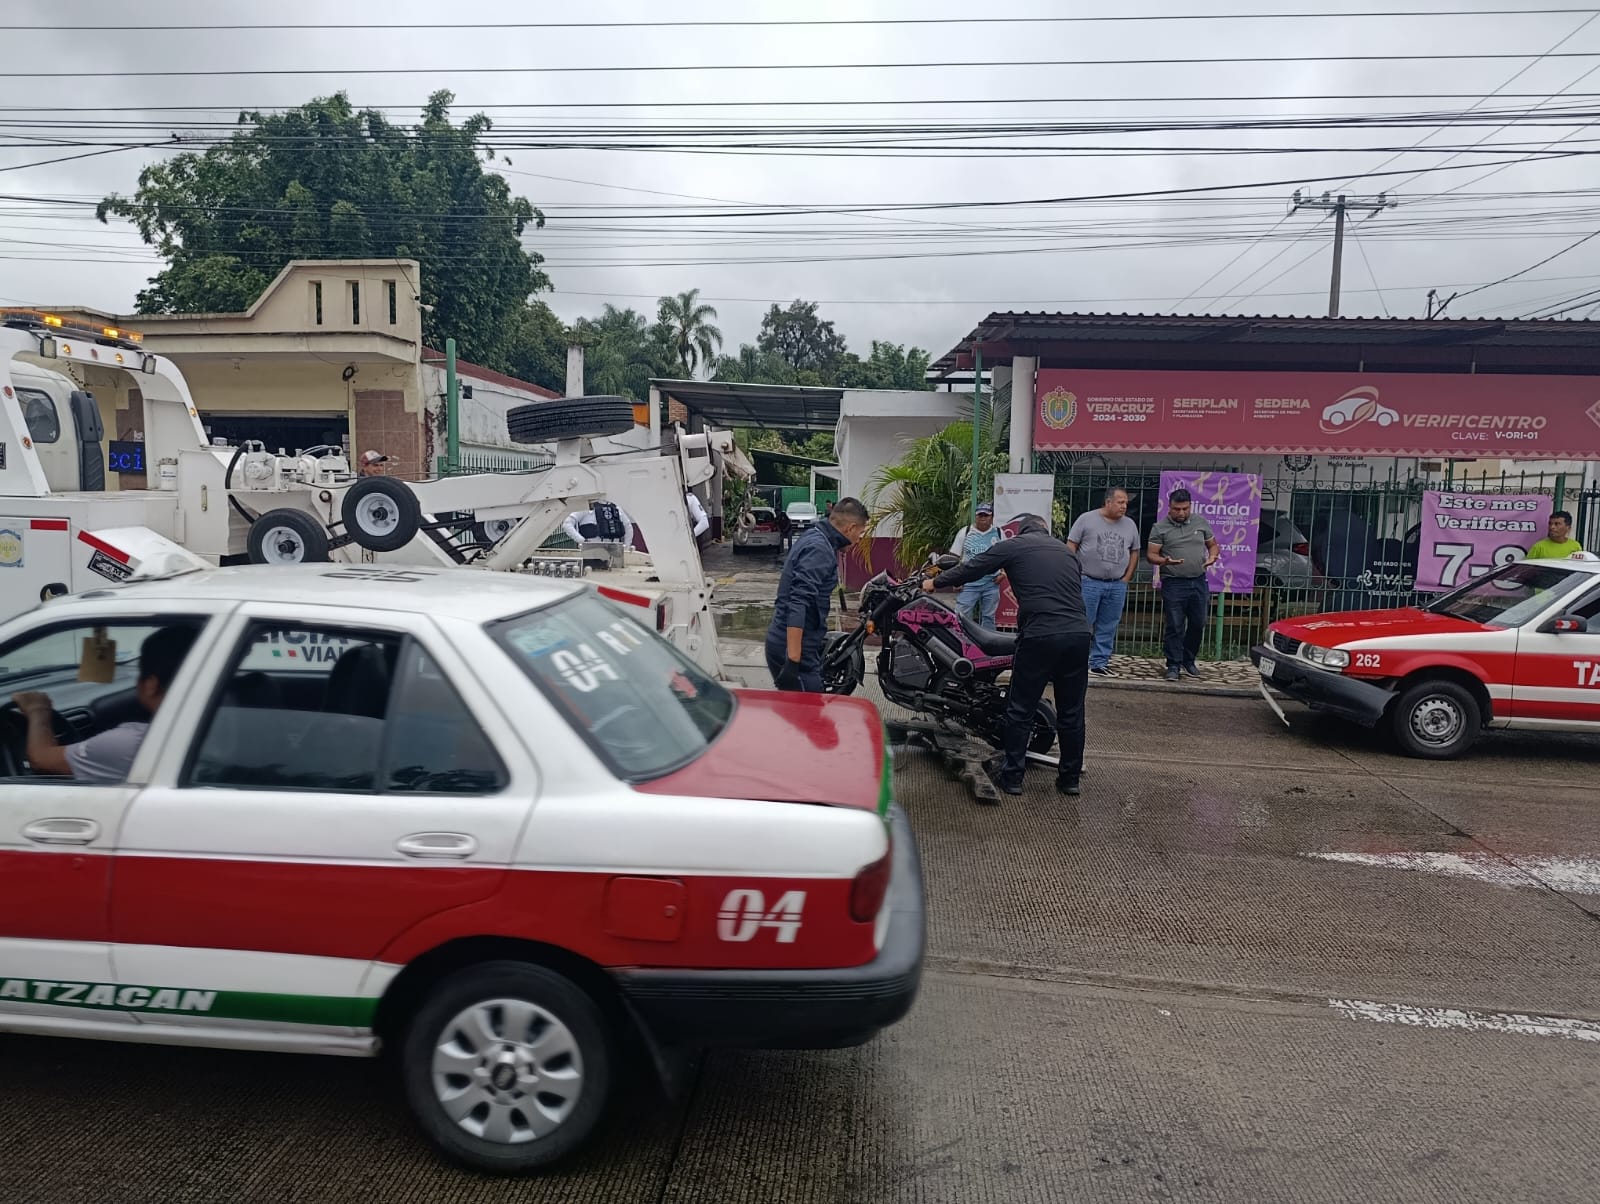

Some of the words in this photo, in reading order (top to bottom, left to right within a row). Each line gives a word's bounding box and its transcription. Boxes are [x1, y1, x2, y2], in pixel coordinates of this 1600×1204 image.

[1086, 403, 1155, 413] VERACRUZ
[1173, 398, 1239, 408] SEFIPLAN
[1254, 398, 1311, 409] SEDEMA
[1402, 414, 1547, 430] VERIFICENTRO
[1451, 431, 1489, 441] CLAVE:
[1495, 431, 1538, 440] V-ORI-01
[1439, 494, 1486, 510] Este
[1490, 500, 1537, 511] mes
[1435, 514, 1537, 532] Verifican
[1356, 654, 1381, 668] 262
[716, 888, 808, 943] 04
[0, 979, 218, 1012] ATZACAN
